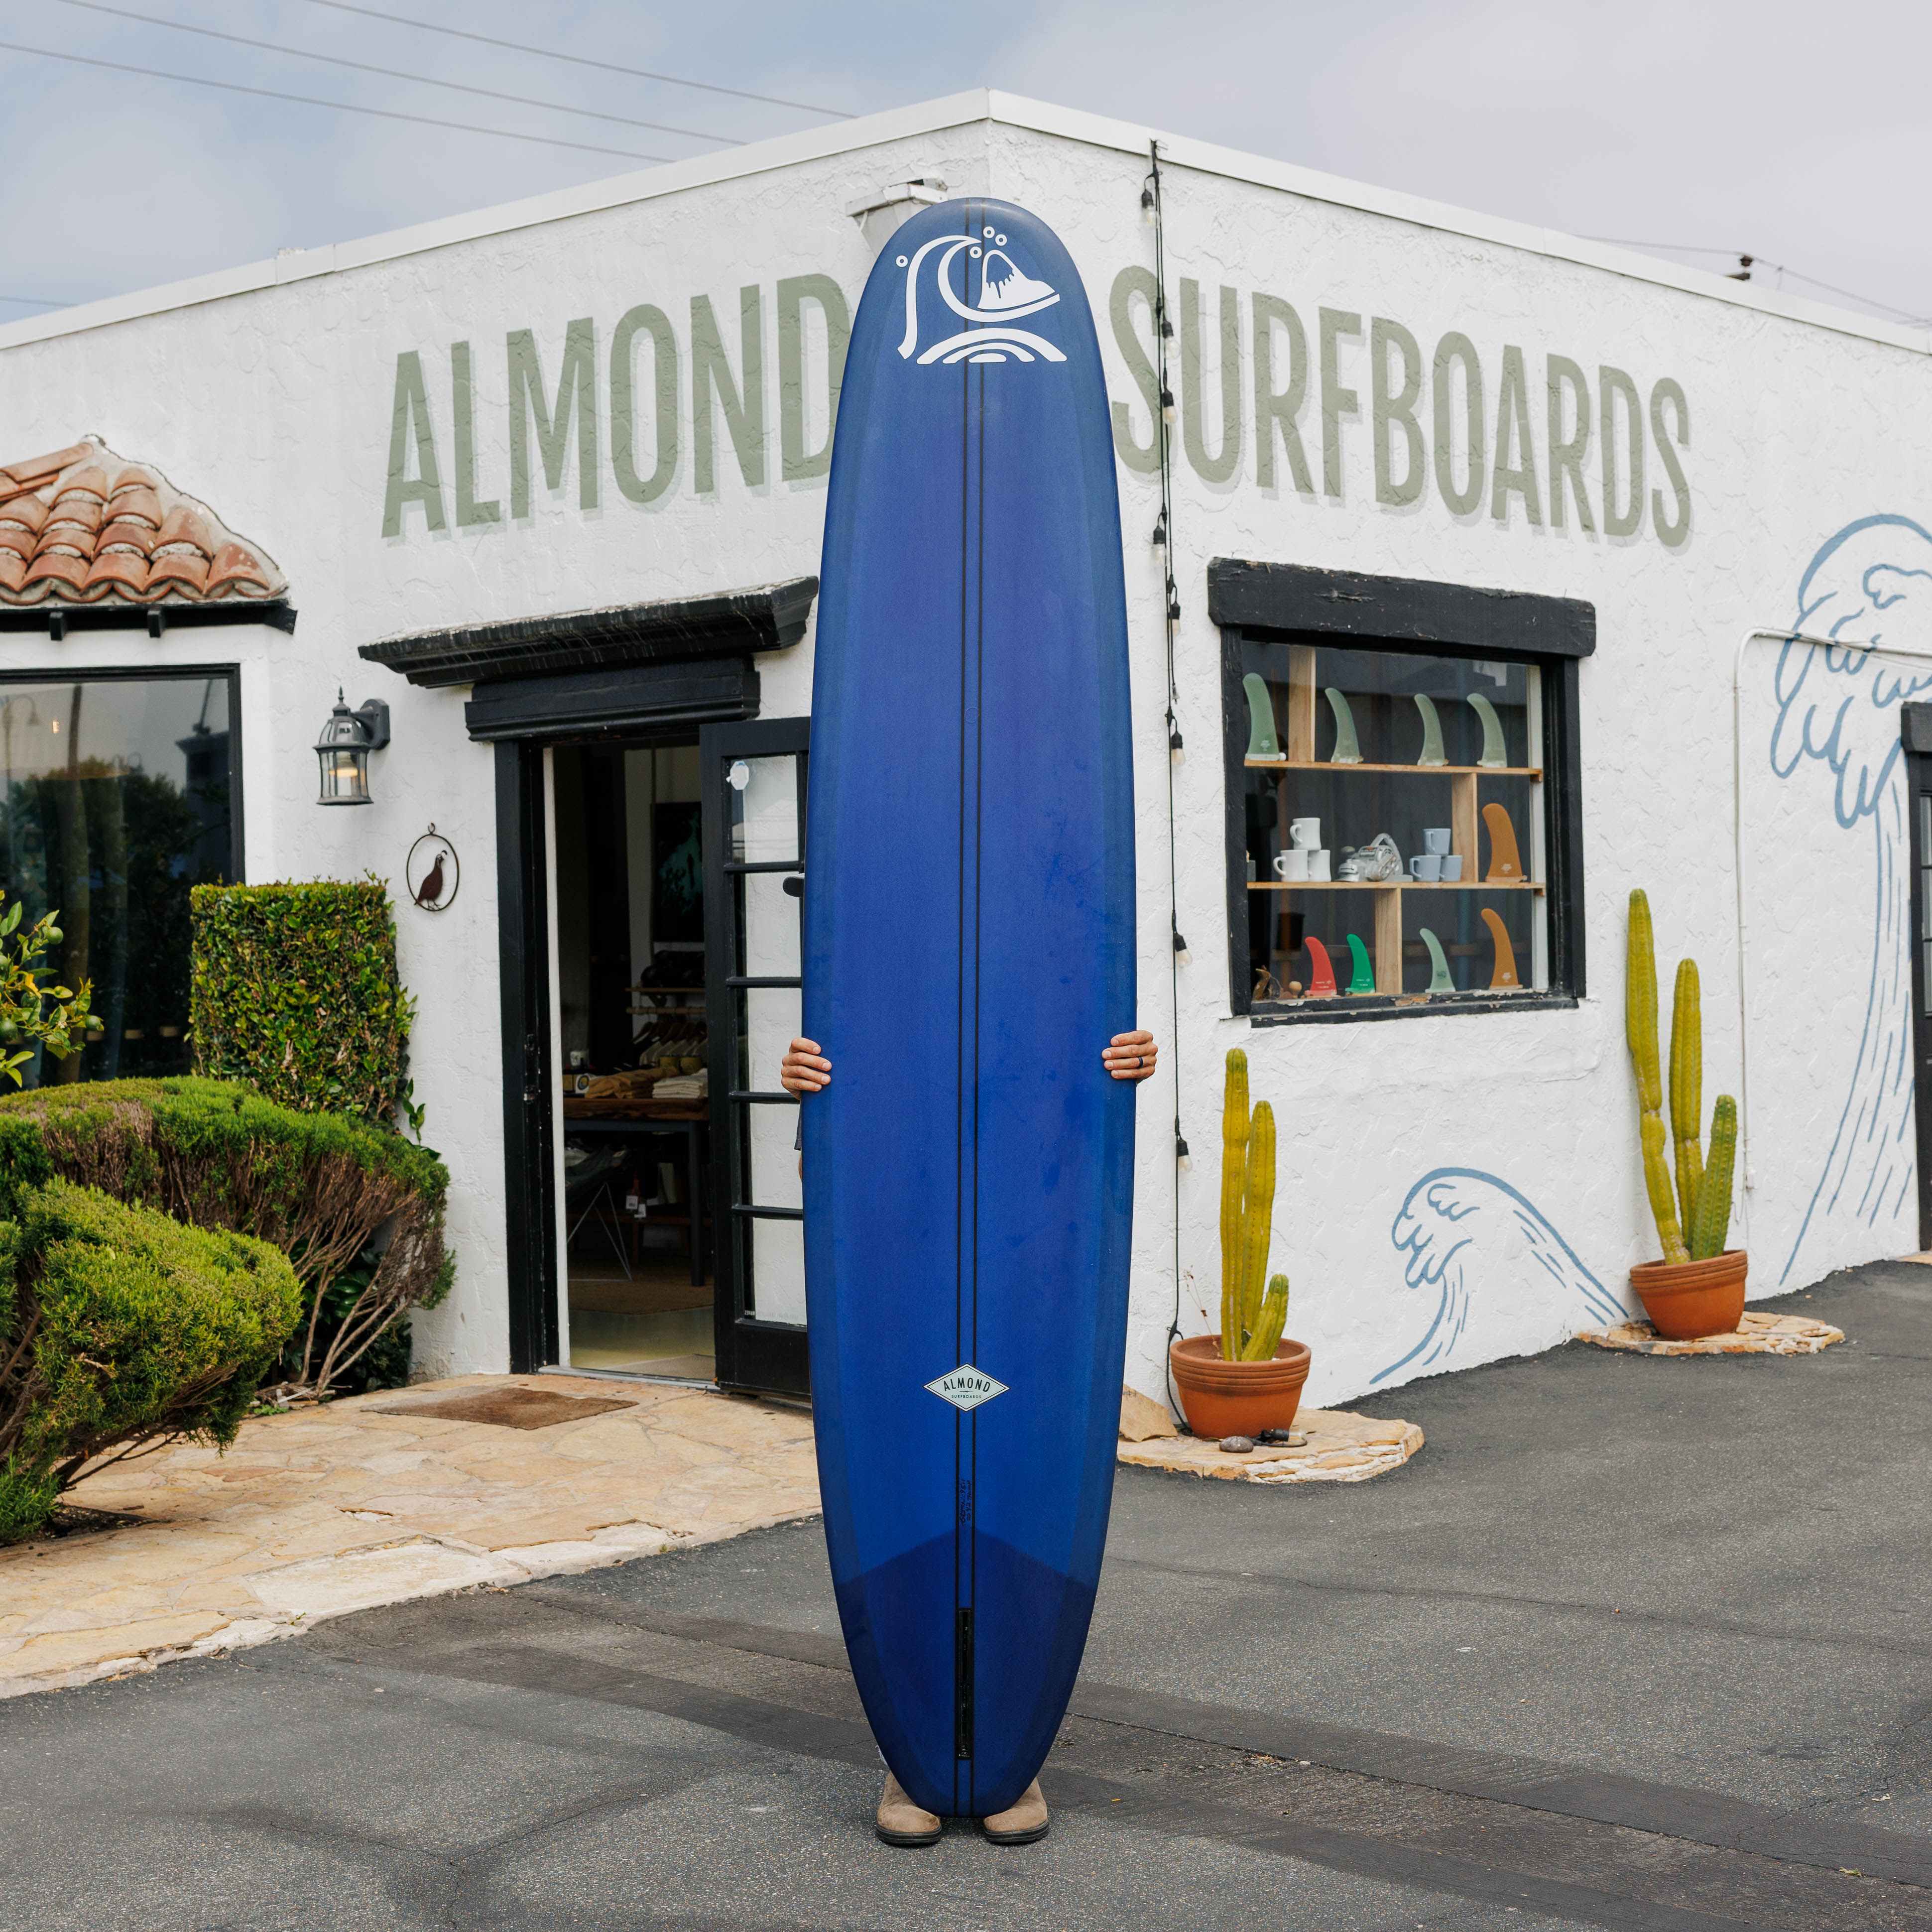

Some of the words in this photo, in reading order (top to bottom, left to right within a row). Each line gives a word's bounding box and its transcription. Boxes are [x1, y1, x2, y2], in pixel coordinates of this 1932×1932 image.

[381, 273, 851, 538] ALMOND
[1109, 265, 1692, 547] SURFBOARDS
[944, 1377, 990, 1392] ALMOND
